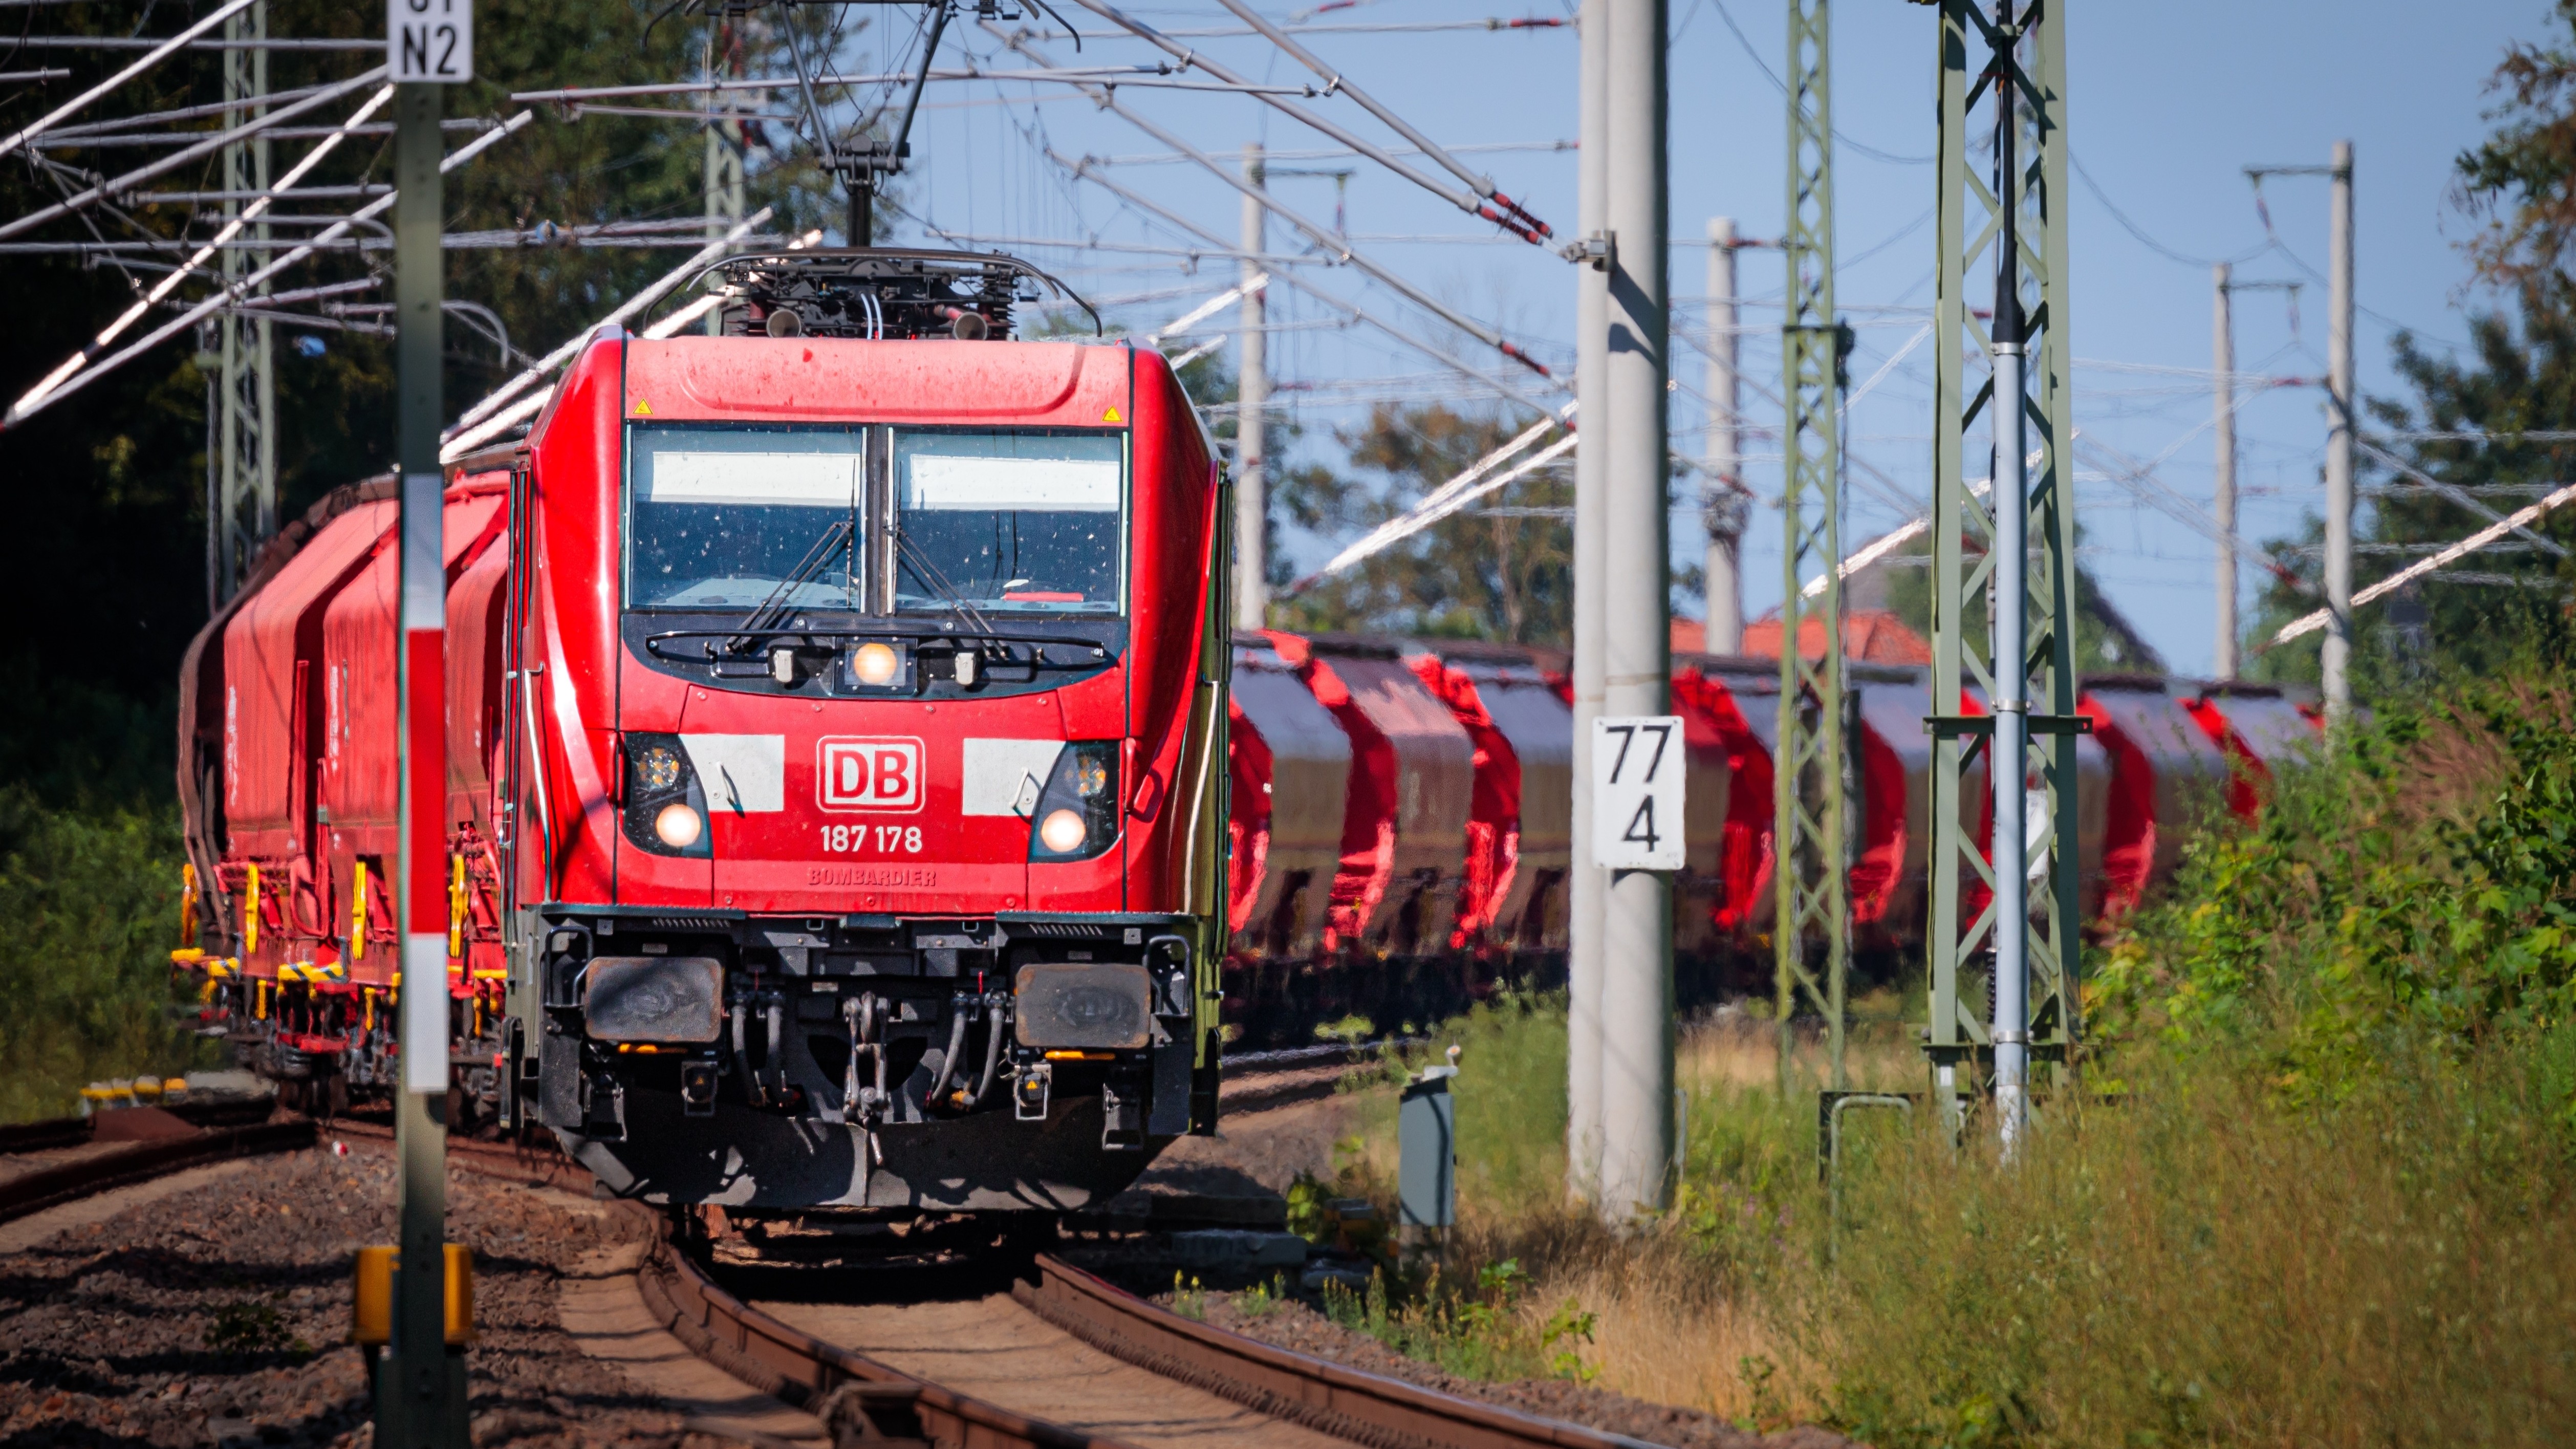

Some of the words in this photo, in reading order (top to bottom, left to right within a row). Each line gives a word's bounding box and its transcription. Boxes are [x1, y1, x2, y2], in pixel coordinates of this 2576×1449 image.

[403, 24, 457, 75] N2
[832, 749, 910, 799] DB
[1605, 725, 1672, 784] 77
[820, 825, 867, 852] 187
[875, 826, 922, 853] 178
[1621, 794, 1660, 853] 4
[809, 868, 936, 886] BOMBARDIER
